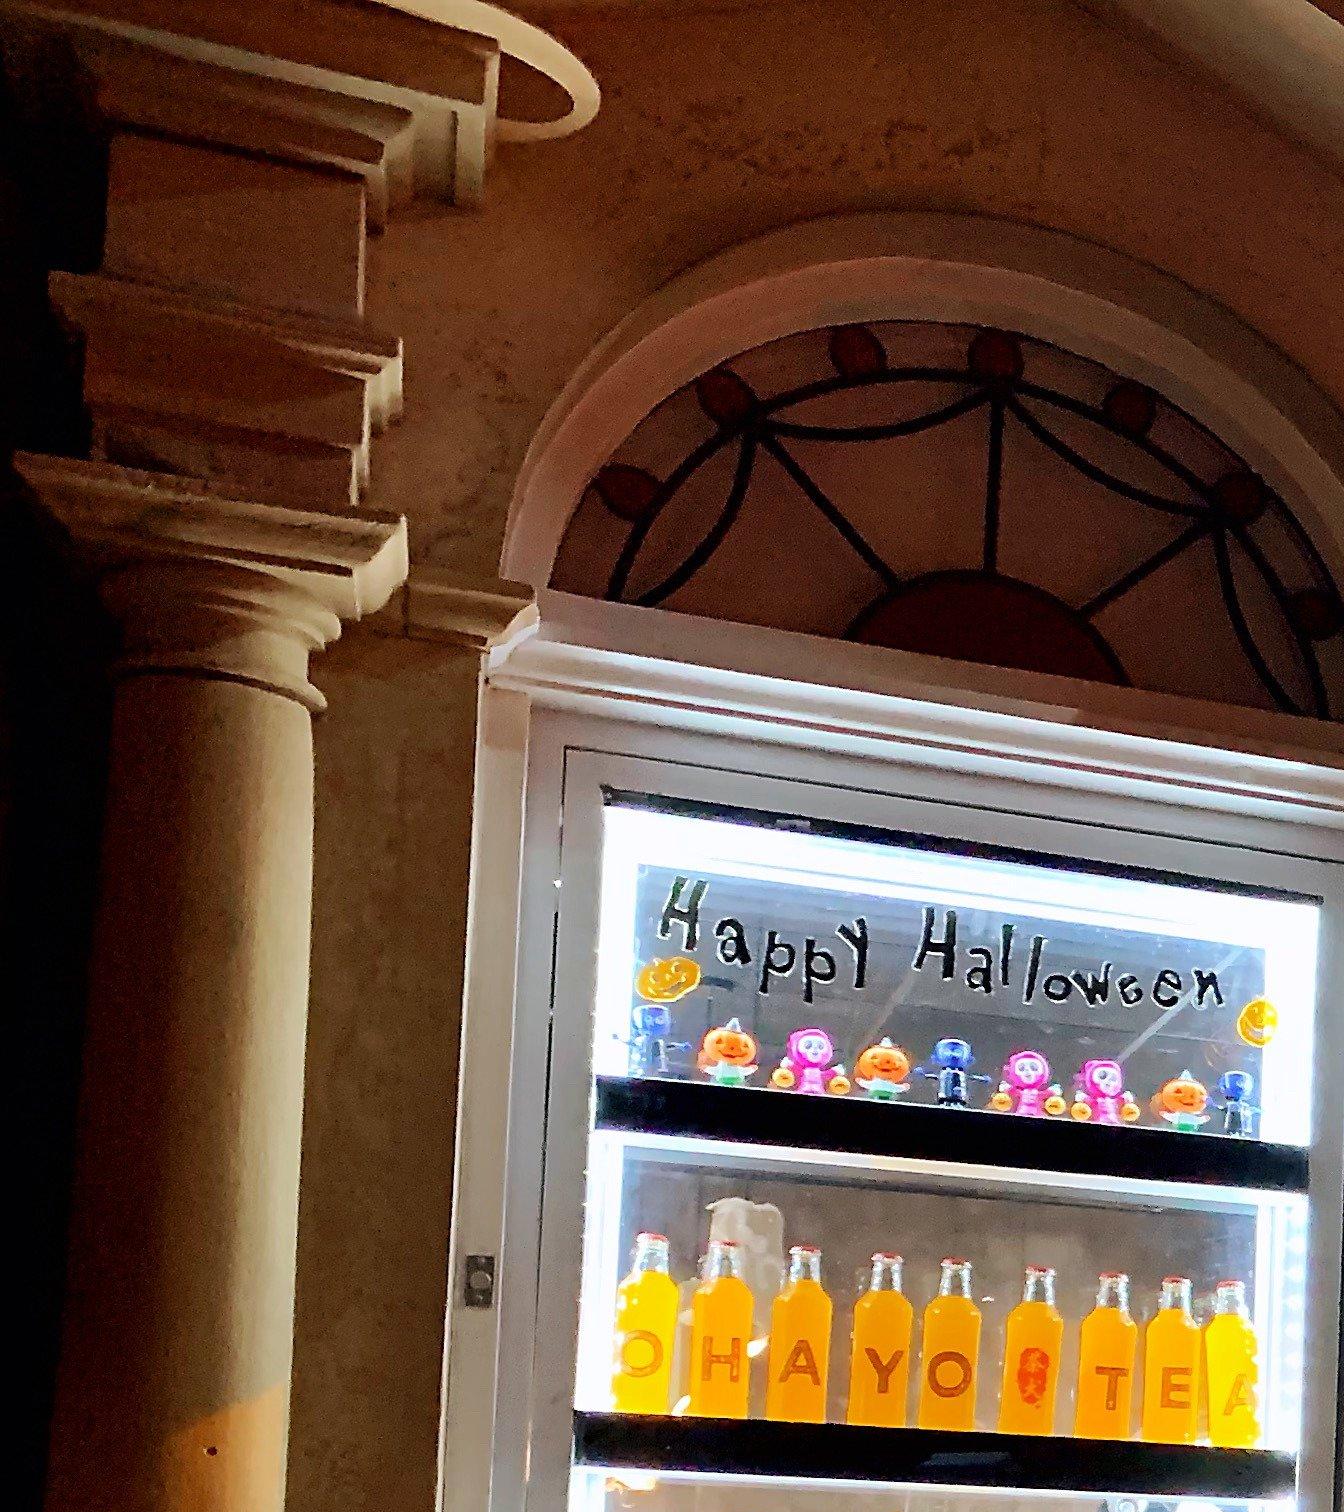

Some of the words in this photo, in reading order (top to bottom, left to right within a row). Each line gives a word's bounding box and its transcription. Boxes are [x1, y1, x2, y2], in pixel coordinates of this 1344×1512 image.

[656, 874, 870, 1005] Happy
[912, 905, 1226, 1010] Halloween
[620, 1327, 974, 1399] OHAYO
[1095, 1364, 1253, 1417] TEA
